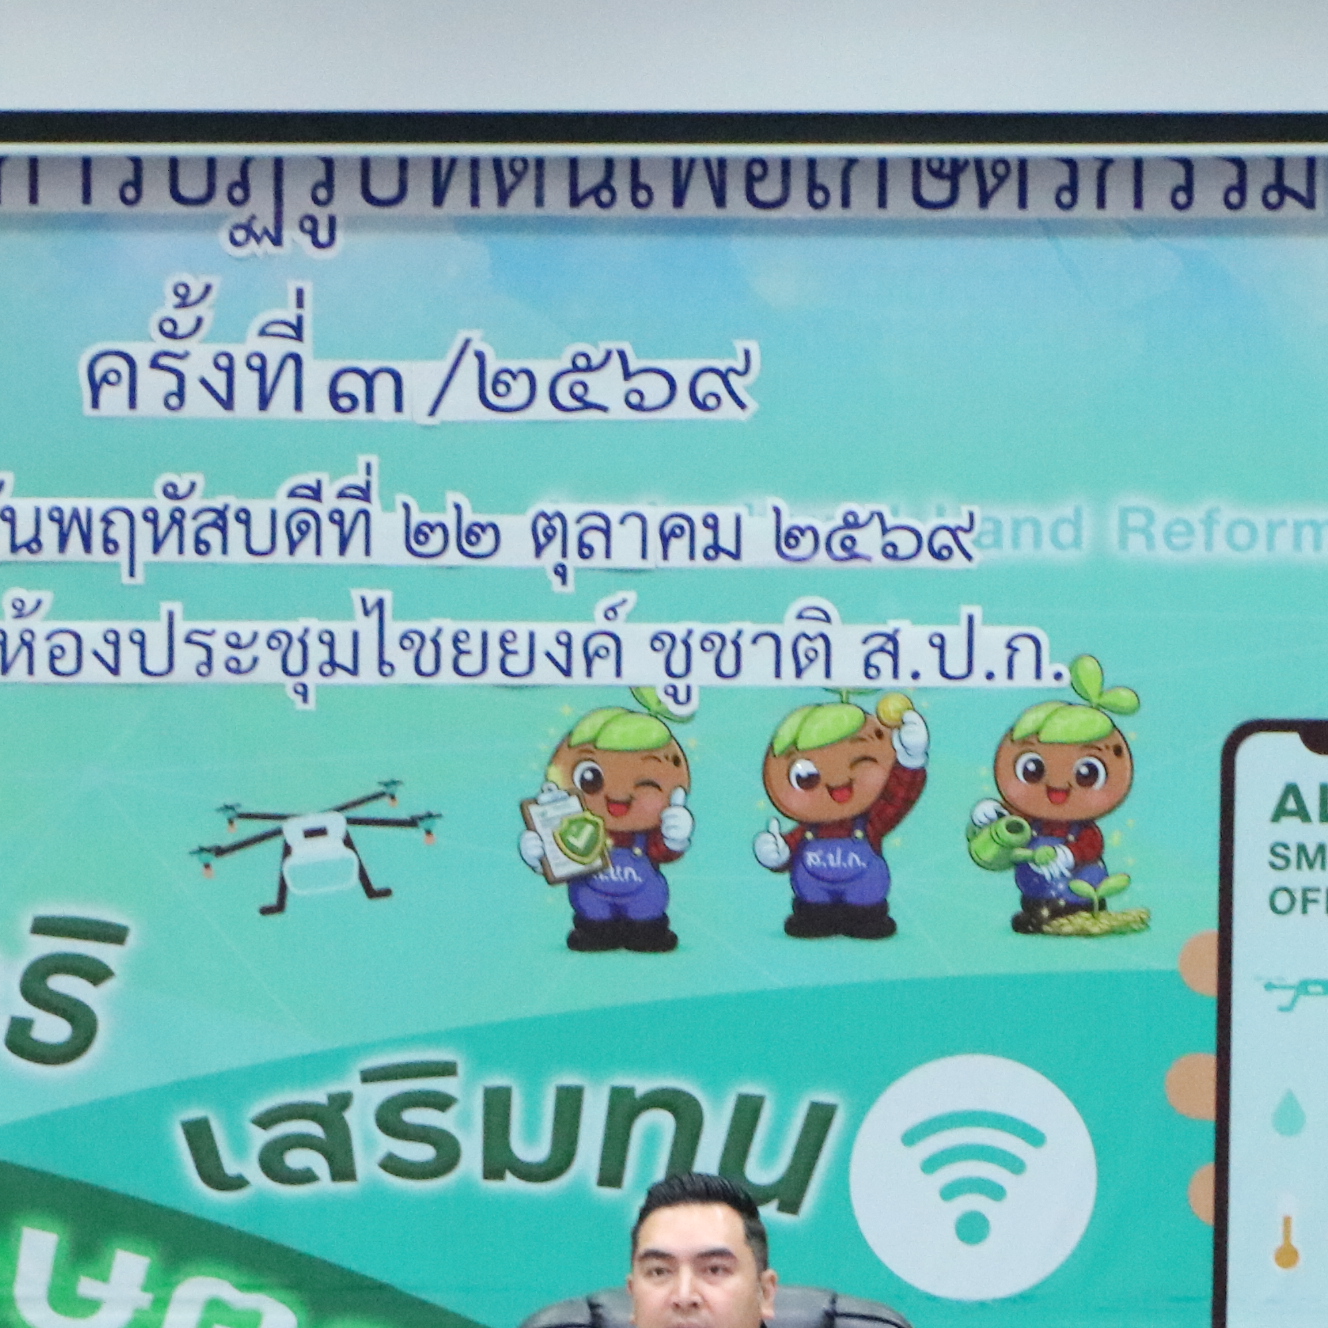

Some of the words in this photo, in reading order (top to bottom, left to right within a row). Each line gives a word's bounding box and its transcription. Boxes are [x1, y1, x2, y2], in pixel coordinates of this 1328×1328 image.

[87, 281, 304, 412] ครั้งที่
[328, 366, 403, 414] ๓
[428, 338, 751, 417] /๒๕๖๙
[402, 501, 502, 560] ๒๒
[531, 508, 742, 587] ตุลาคม
[772, 506, 975, 562] ๒๕๖๙
[938, 504, 1083, 550] and
[650, 606, 833, 709] ชูชาติ
[860, 613, 1066, 682] ส.ป.ก.
[180, 1060, 838, 1217] เสริมทน
